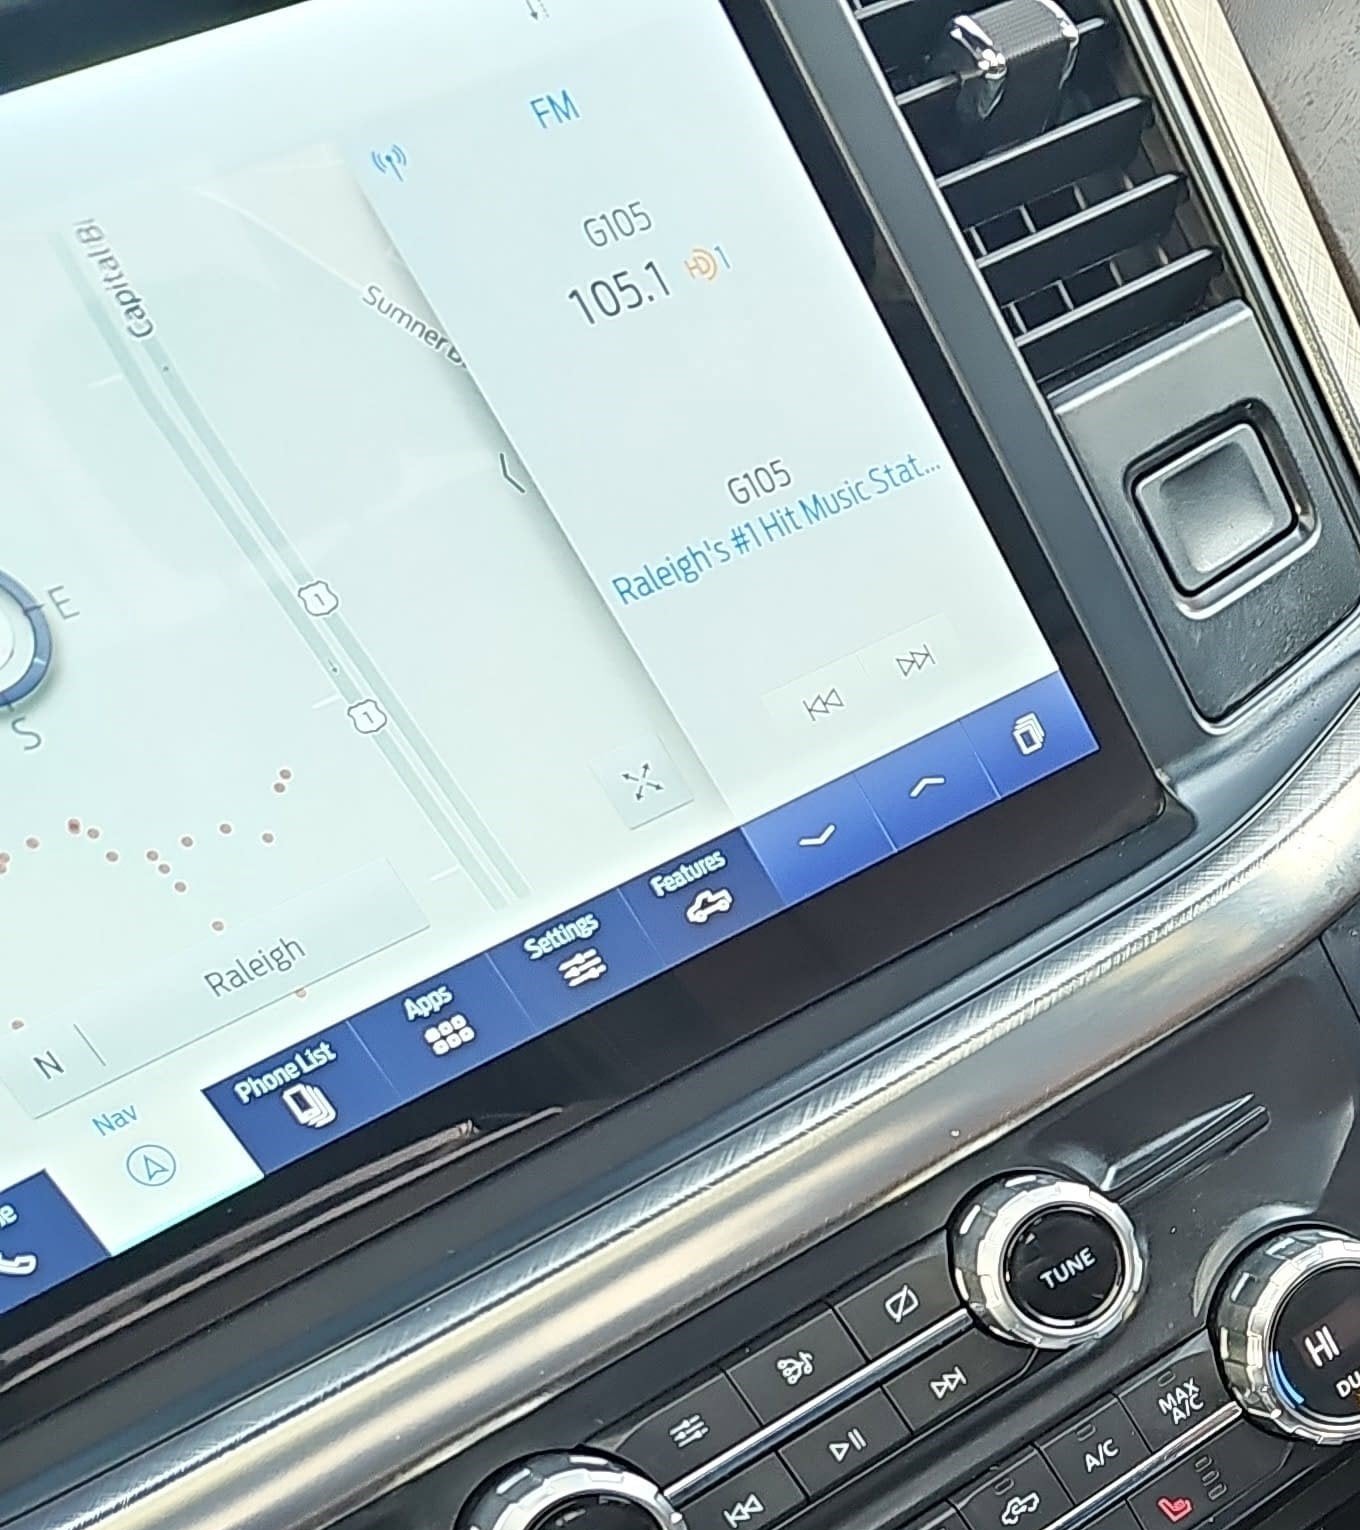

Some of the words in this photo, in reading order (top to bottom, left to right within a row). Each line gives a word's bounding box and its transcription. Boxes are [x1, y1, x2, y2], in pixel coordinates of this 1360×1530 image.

[530, 90, 580, 129] FM
[583, 201, 653, 247] G105
[88, 248, 154, 338] Capital
[568, 260, 671, 325] 105.1
[362, 285, 449, 350] Sumner
[727, 459, 793, 506] G105
[612, 537, 732, 606] Raleigh's
[730, 521, 765, 556] #1
[763, 504, 803, 544] Hit
[799, 477, 872, 527] Music
[47, 585, 81, 620] E
[10, 716, 42, 751] S
[650, 850, 727, 898] Features
[523, 913, 600, 961] Settings
[203, 936, 307, 998] Raleigh
[403, 984, 454, 1021] Apps
[33, 1049, 66, 1080] N
[233, 1058, 302, 1105] Phone
[296, 1041, 337, 1076] List
[92, 1102, 139, 1138] Nav
[1040, 1247, 1097, 1290] TUNE
[1305, 1326, 1340, 1367] HI
[1158, 1378, 1200, 1414] MAX
[1171, 1396, 1205, 1426] A/C
[1083, 1440, 1119, 1473] A/C
